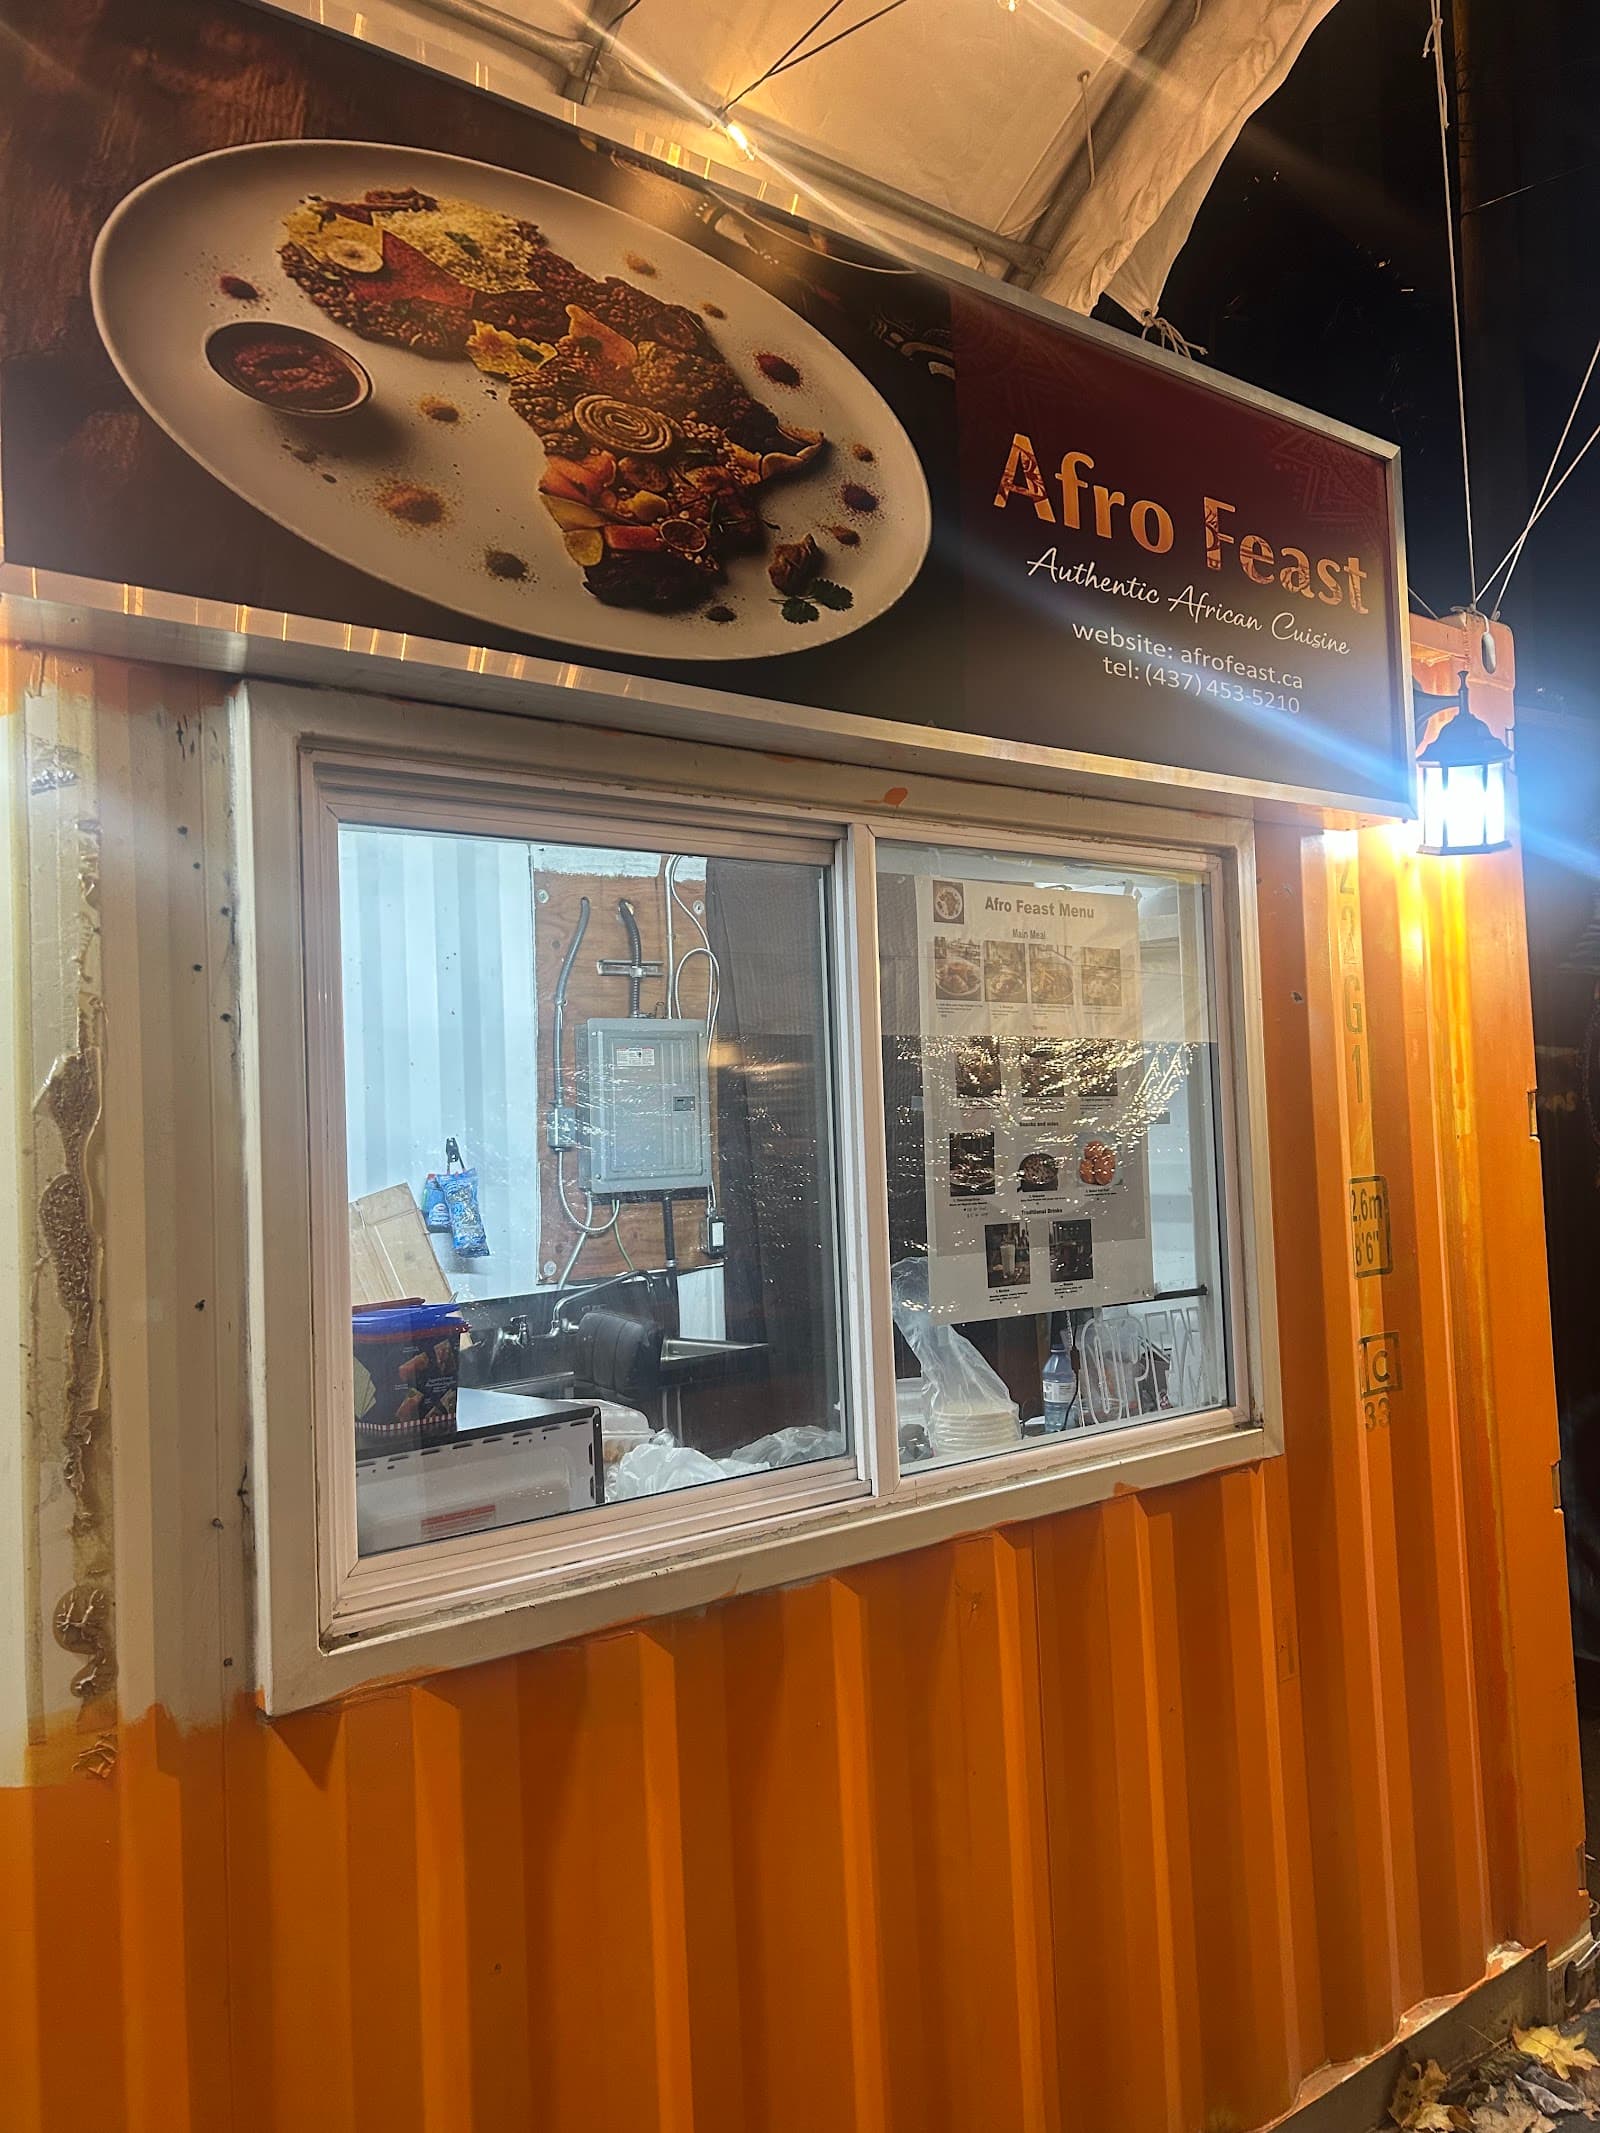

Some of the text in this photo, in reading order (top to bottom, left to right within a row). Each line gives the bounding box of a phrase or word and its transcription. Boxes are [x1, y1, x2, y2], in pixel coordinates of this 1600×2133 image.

[993, 432, 1369, 614] Afro Feast
[1026, 546, 1350, 656] Authentic African Cuisine
[1071, 623, 1304, 690] website: afrofeast.ca
[1102, 656, 1301, 714] tel: (437) 453-5210
[984, 896, 1095, 919] Afro Feast Menu
